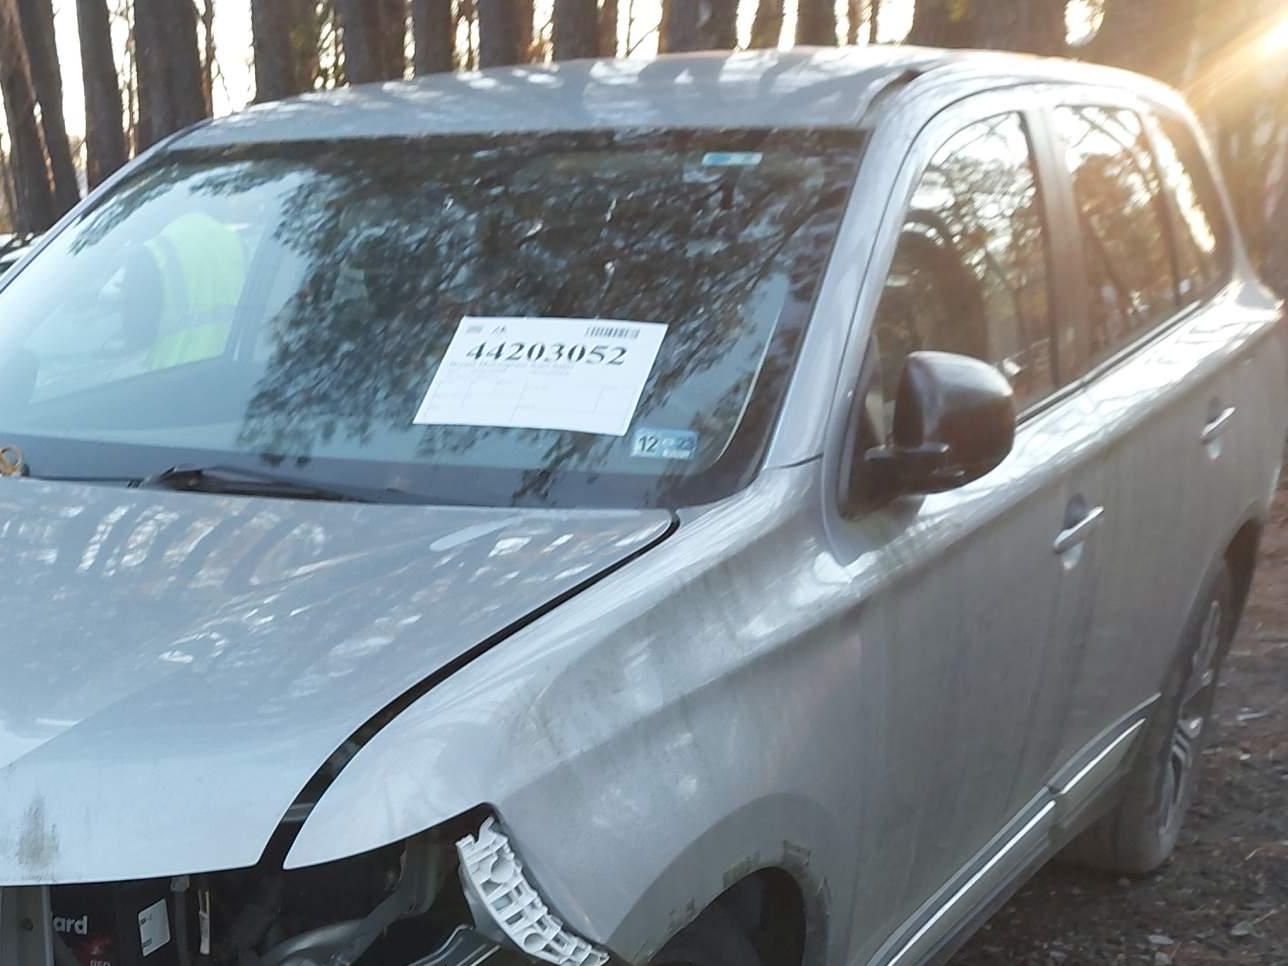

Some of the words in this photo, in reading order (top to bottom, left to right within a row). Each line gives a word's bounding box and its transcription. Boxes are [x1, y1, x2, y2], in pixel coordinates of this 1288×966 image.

[466, 341, 627, 366] 44203052
[639, 434, 658, 452] 12
[53, 915, 88, 935] ard
